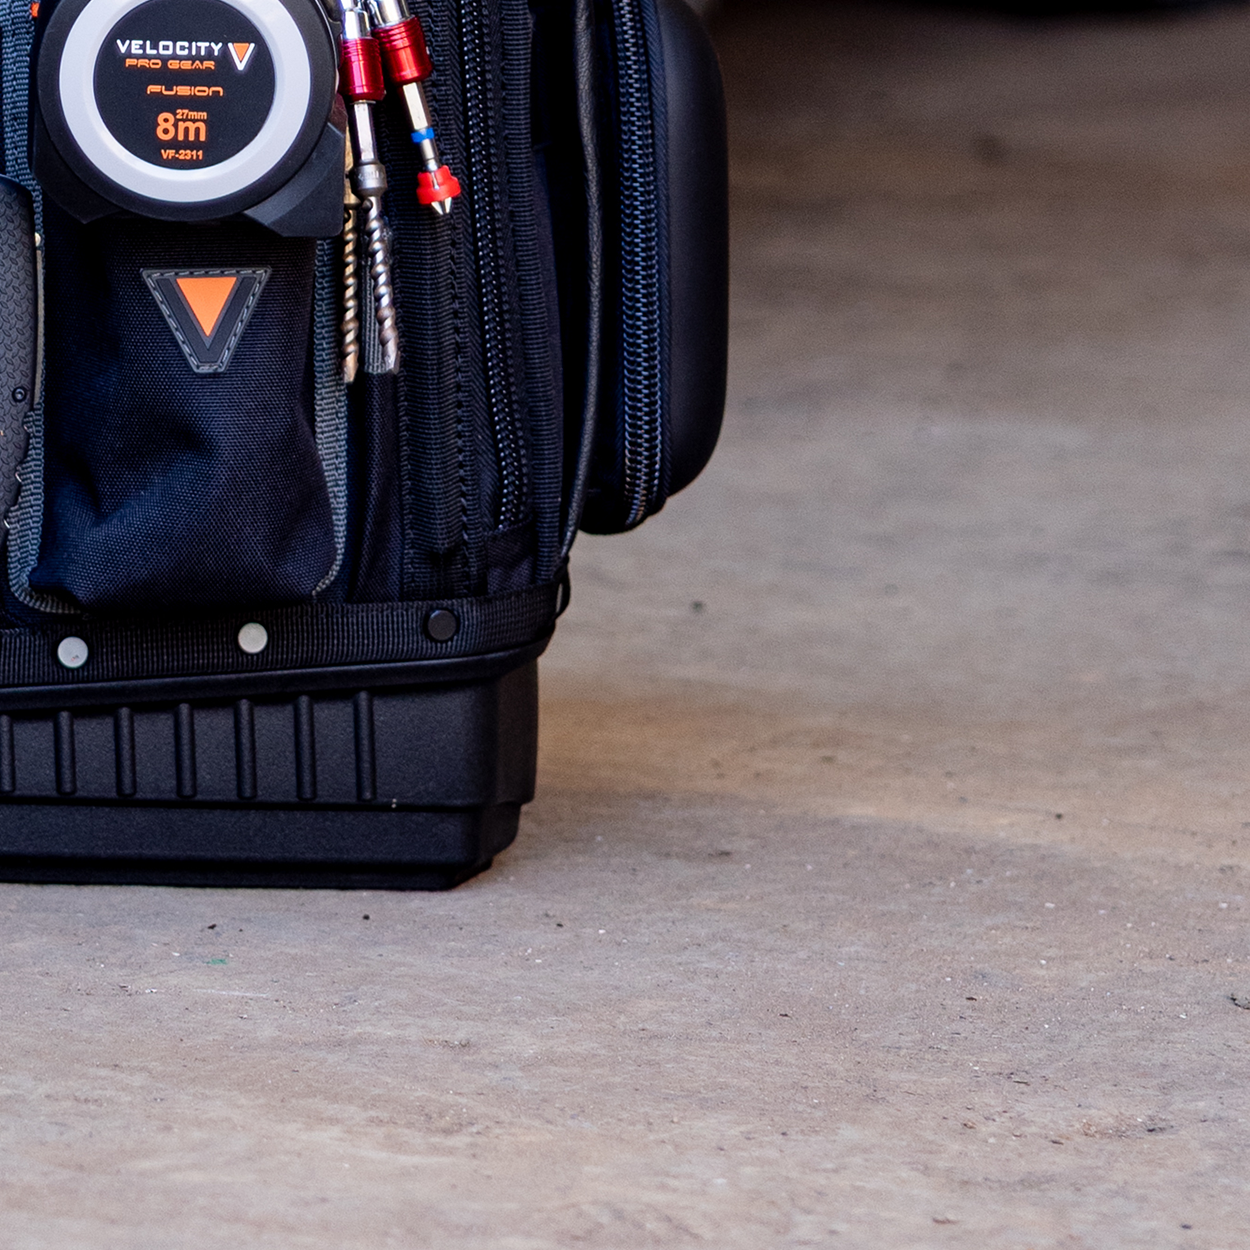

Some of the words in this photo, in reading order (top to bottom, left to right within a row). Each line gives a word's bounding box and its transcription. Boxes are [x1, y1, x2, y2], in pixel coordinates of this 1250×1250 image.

[116, 39, 223, 56] VELOCITY
[125, 58, 162, 69] PRO
[167, 60, 215, 70] GEAR
[175, 109, 207, 120] 27mm
[156, 112, 206, 141] 8m
[161, 149, 203, 160] VF-2311
